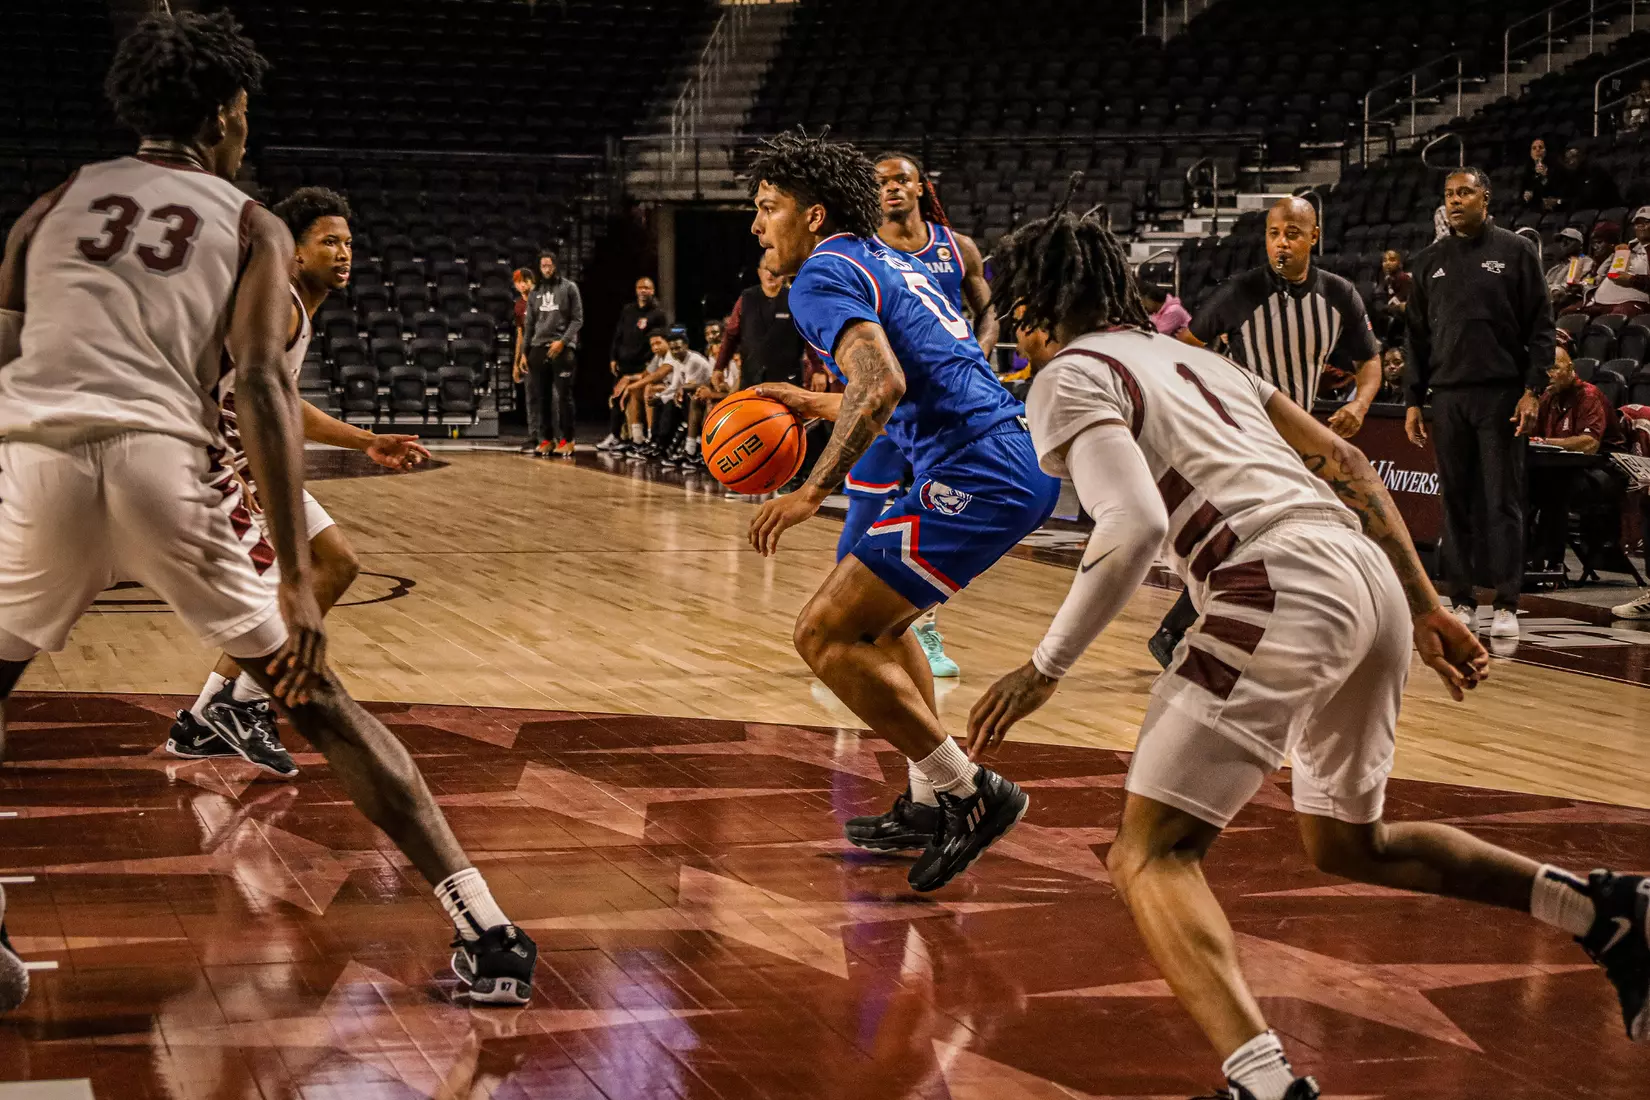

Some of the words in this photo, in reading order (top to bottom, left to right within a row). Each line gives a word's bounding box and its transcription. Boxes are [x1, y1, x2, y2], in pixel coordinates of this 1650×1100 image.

[77, 193, 204, 277] 33
[901, 272, 970, 340] 0
[1173, 361, 1245, 432] 1
[717, 433, 764, 474] ELITE
